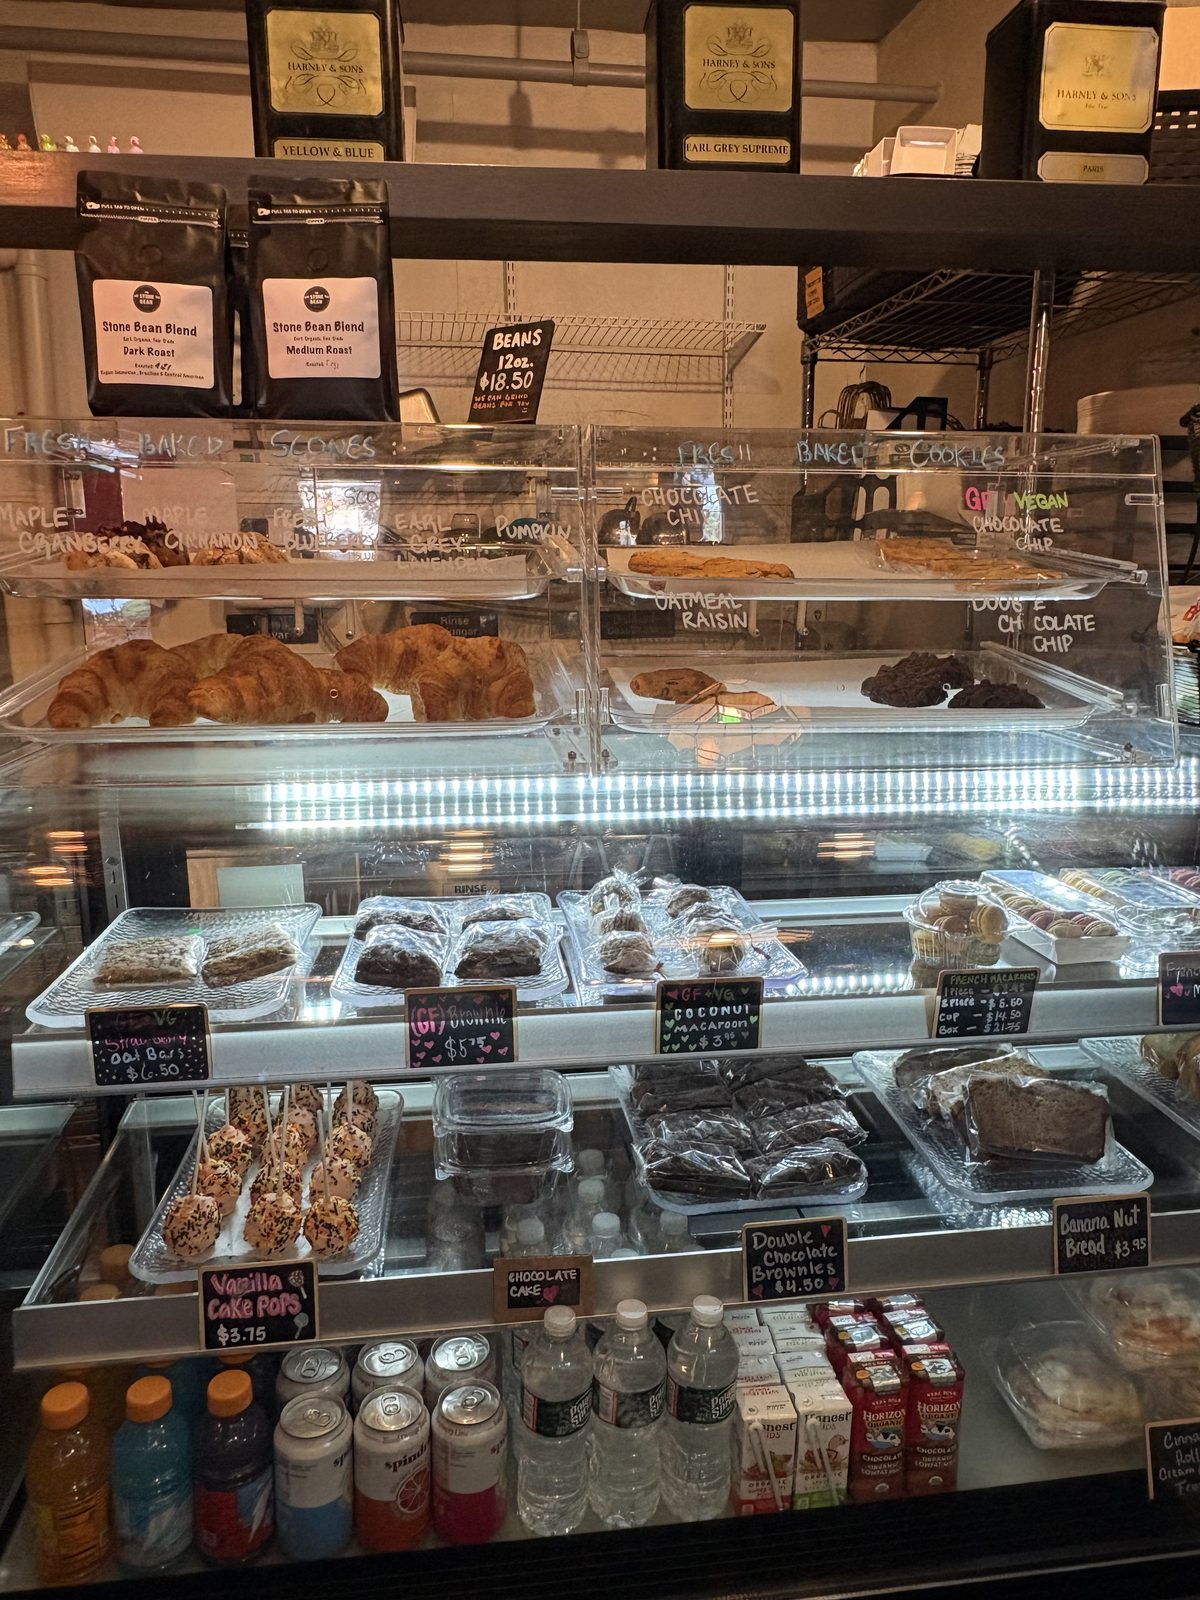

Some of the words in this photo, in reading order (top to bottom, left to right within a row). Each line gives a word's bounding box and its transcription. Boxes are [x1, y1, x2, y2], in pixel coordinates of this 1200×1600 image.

[287, 62, 328, 72] HARNEY
[329, 63, 337, 73] &
[339, 64, 365, 74] SONS
[702, 58, 740, 68] HARNEY
[742, 60, 751, 69] &
[752, 60, 776, 70] SONS
[1056, 88, 1098, 101] HARNEY
[1100, 91, 1109, 101] &
[1111, 92, 1138, 102] SONS
[282, 145, 330, 157] YELLOW
[332, 146, 343, 158] &
[345, 147, 375, 159] BLUE
[686, 142, 711, 153] EARL
[713, 143, 740, 154] GREY
[742, 144, 789, 155] SUPREME
[1082, 164, 1105, 174] PARIS
[102, 320, 131, 333] Stone
[134, 321, 162, 334] Bean
[165, 323, 198, 337] Blend
[272, 321, 302, 333] Stone
[304, 321, 332, 332] Bean
[334, 320, 365, 332] Blend
[492, 328, 543, 351] BEANS
[123, 346, 145, 356] Dark
[147, 347, 175, 358] Roast
[286, 345, 324, 355] Medium
[326, 345, 352, 355] Roast
[498, 353, 534, 371] 12oz.
[480, 370, 534, 392] $18.50
[474, 394, 486, 402] WE
[487, 394, 502, 402] CAN
[138, 431, 224, 458] BAKED
[269, 429, 377, 460] SCONES
[677, 440, 752, 465] FRESH
[1013, 490, 1069, 512] VEGAN
[0, 500, 70, 532] MAPLE
[142, 505, 208, 526] MAPLE
[394, 512, 452, 534] EARL
[972, 515, 1065, 534] CHOCOLATE
[494, 514, 572, 540] PUMPKIN
[18, 530, 143, 561] CRANBERRY
[163, 529, 260, 551] CINNAMON
[408, 534, 467, 554] GREY
[1015, 536, 1054, 553] CHIP
[653, 589, 743, 611] OATMEAL
[971, 595, 1047, 613] DOUBE
[682, 610, 749, 630] RAISIN
[997, 613, 1097, 633] CHCOLATE
[1032, 633, 1074, 653] CHIP
[454, 883, 488, 894] RINSE
[950, 974, 988, 985] FRENCH
[681, 987, 703, 1002] GF
[410, 1003, 446, 1038] (GF)
[448, 1004, 507, 1030] Brownie
[674, 1003, 751, 1021] COCONUT
[110, 1048, 140, 1065] Oat
[146, 1046, 185, 1061] Bars
[126, 1062, 180, 1083] $6.50
[1060, 1212, 1111, 1236] Banana
[1113, 1203, 1141, 1229] Nut
[751, 1230, 814, 1251] Double
[1065, 1233, 1106, 1259] Bread
[1114, 1237, 1147, 1260] $3.95
[763, 1243, 839, 1267] Chocolate
[508, 1269, 578, 1284] CHOCOLATE
[751, 1261, 837, 1284] Brownies
[209, 1271, 283, 1296] Vanilla
[509, 1283, 542, 1298] CAKE
[774, 1277, 824, 1294] $4.50
[216, 1323, 267, 1347] $3.75
[748, 1479, 787, 1489] ORGAIC
[804, 1471, 843, 1481] ORGAIC
